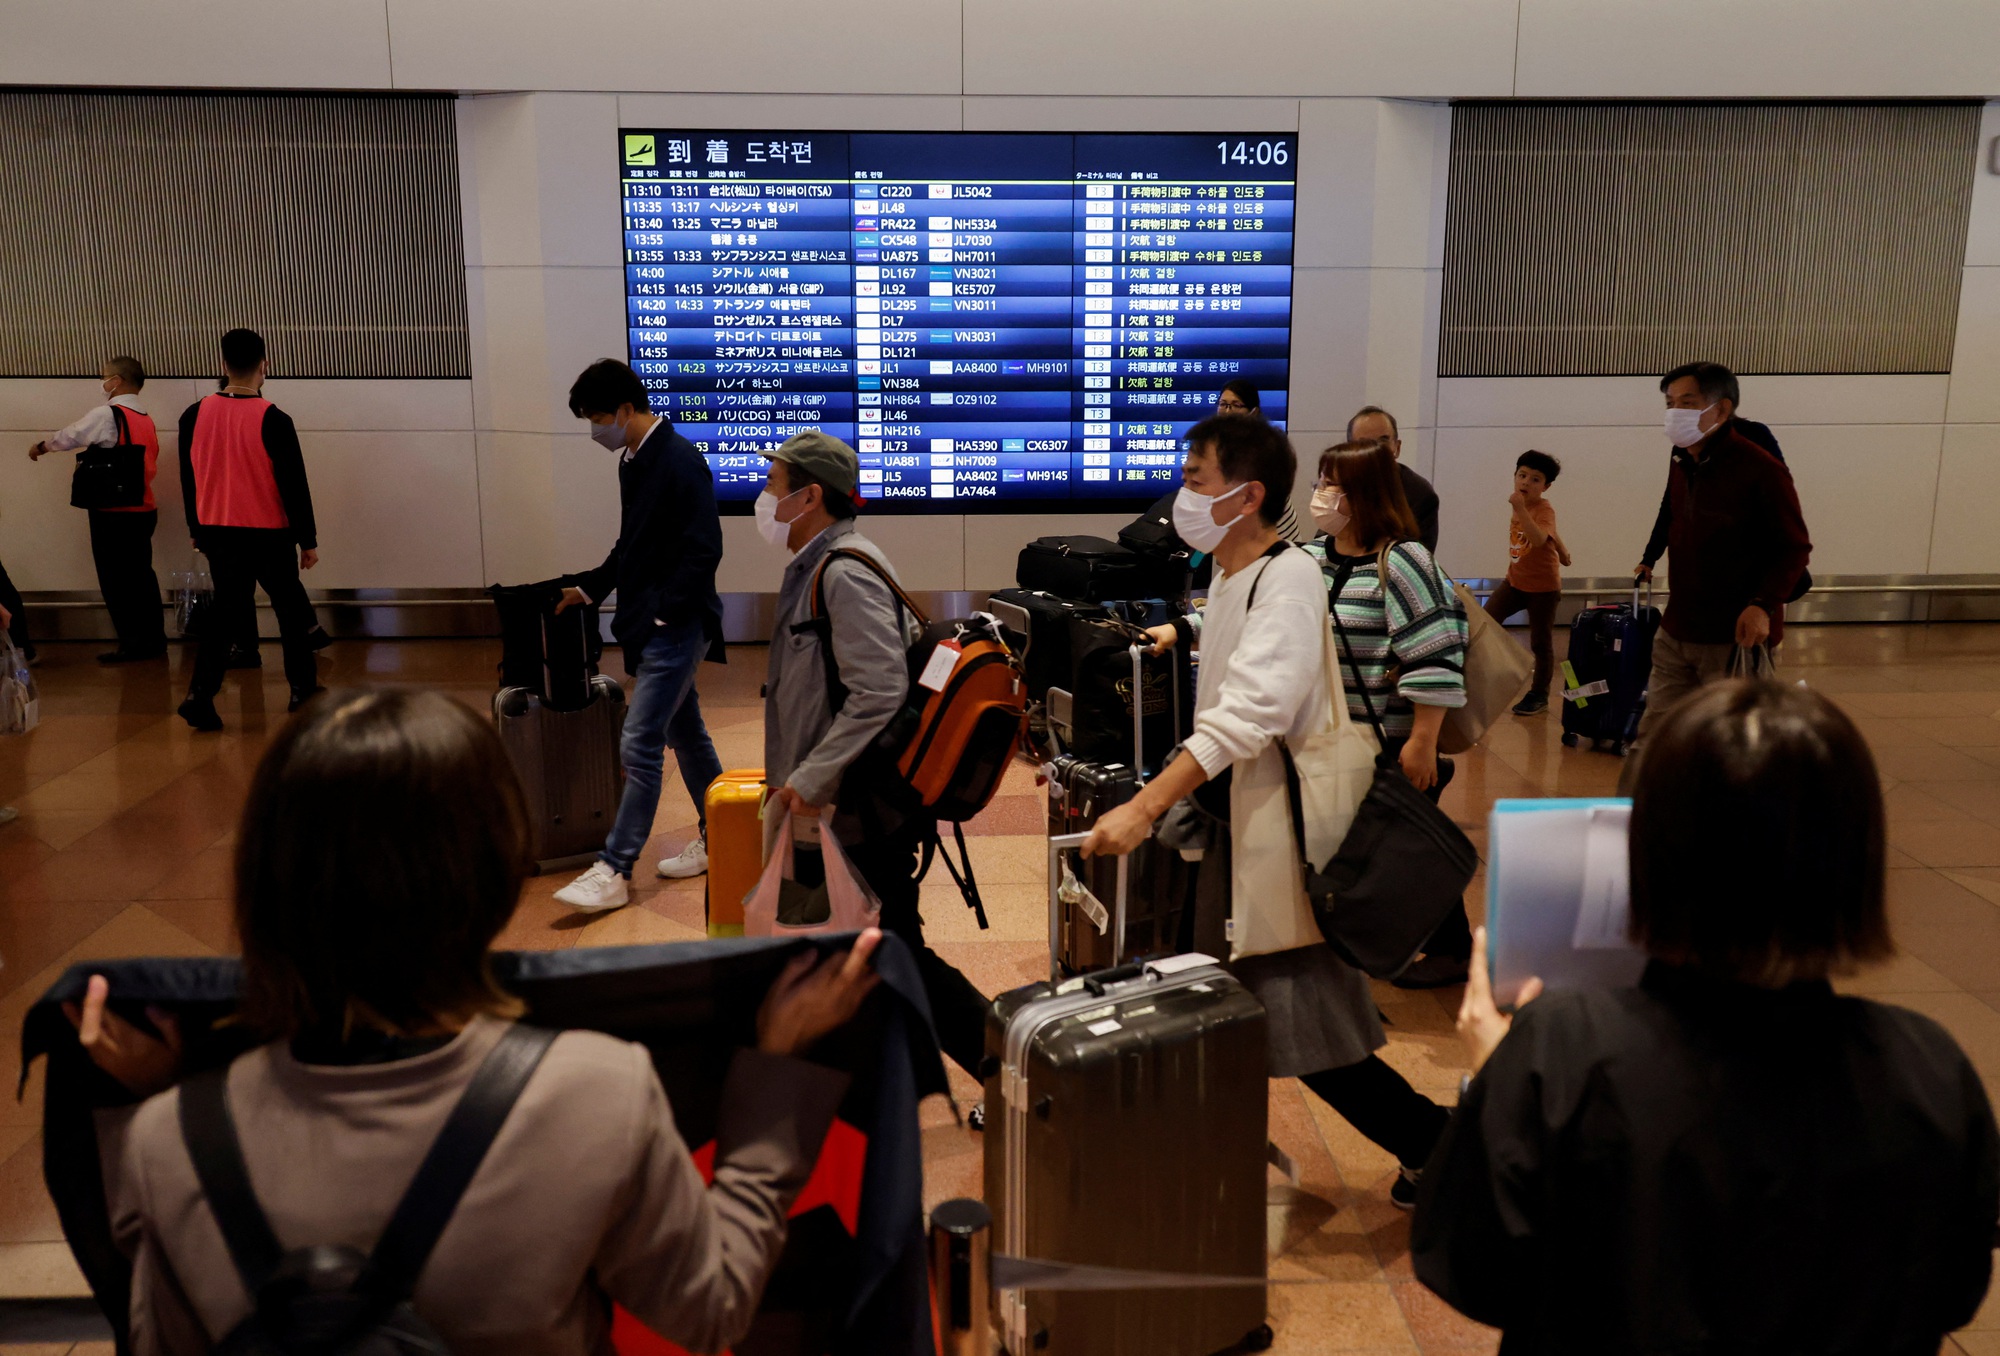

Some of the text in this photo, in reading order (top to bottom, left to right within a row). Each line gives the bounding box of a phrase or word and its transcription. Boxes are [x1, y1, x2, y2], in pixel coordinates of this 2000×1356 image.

[669, 140, 811, 163] 到 着 도착편
[1218, 142, 1287, 164] 14:06
[633, 185, 661, 196] 13:10
[671, 186, 698, 196] 13:11
[709, 185, 832, 197] 台北(松山) 타이베이(TSA)
[881, 187, 912, 197] CI220
[954, 187, 991, 197] JL5042
[1131, 187, 1264, 198] 手荷物引渡中 수하물 인도중
[633, 202, 661, 212] 13:35
[672, 202, 700, 212] 13:17
[710, 202, 798, 213] ヘルシンキ 헬싱키
[880, 203, 905, 213] JL48
[1131, 203, 1264, 214] 手荷物引渡中 수하물 인도중
[634, 218, 662, 228] 13:40
[672, 218, 700, 229] 13:25
[711, 218, 778, 229] マニラ 마닐라
[881, 219, 915, 229] PR422
[955, 219, 997, 230] NH5334
[1130, 219, 1263, 230] 手荷物引渡中 수하물 인도중
[635, 234, 663, 245] 13:55
[711, 234, 757, 245] 香港 홍콩
[881, 235, 916, 245] CX548
[954, 235, 992, 246] JL7030
[1130, 235, 1176, 246] 欠航 결항
[635, 251, 663, 261] 13:55
[674, 251, 701, 261] 13:33
[711, 251, 786, 261] サンフランシスコ
[791, 251, 846, 261] 샌프란시스코
[882, 251, 918, 261] UA875
[955, 251, 995, 261] NH7011
[1130, 251, 1262, 261] 手荷物引渡中 수하물 인도중
[636, 268, 664, 278] 14:00
[713, 267, 789, 278] シアトル 시애틀
[882, 268, 916, 278] DL167
[954, 268, 995, 278] VN3021
[1130, 268, 1175, 278] 欠航 결항
[637, 284, 665, 294] 14:15
[675, 284, 703, 294] 14:15
[713, 283, 823, 294] ソウル(金浦) 서울(GMP)
[881, 284, 905, 294] JL92
[955, 284, 995, 294] KE5707
[1129, 284, 1241, 294] 共同運航便 공동 운항편
[637, 300, 666, 310] 14:20
[675, 300, 703, 310] 14:33
[713, 300, 764, 310] アトランタ
[882, 300, 916, 310] DL295
[954, 300, 995, 310] VN3011
[1129, 299, 1241, 310] 共同運航便 공동 운항편
[638, 316, 666, 326] 14:40
[714, 315, 775, 325] ロサンゼルス
[883, 316, 903, 326] DL7
[1129, 315, 1174, 326] 欠航 결항
[639, 332, 667, 342] 14:40
[714, 331, 822, 341] デトロイト 디트로이트
[883, 332, 916, 342] DL275
[955, 332, 995, 342] VN3031
[1129, 331, 1174, 341] 欠航 결항
[640, 348, 667, 357] 14:55
[716, 347, 842, 357] ミネアポリス 미니애폴리스
[883, 348, 915, 357] DL121
[1129, 346, 1174, 357] 欠航 결항
[640, 363, 668, 373] 15:00
[678, 364, 705, 373] 14:23
[715, 363, 848, 373] サンフランシスコ 샌프란시스코
[882, 363, 898, 373] JL1
[955, 363, 997, 373] AA8400
[1027, 363, 1067, 372] MH9101
[1128, 362, 1238, 372] 共同運航便 공동 운항편
[641, 379, 668, 389] 15:05
[716, 378, 781, 388] ハノイ 하노이
[883, 379, 919, 388] VN384
[1128, 377, 1173, 387] 欠航 결항
[648, 396, 669, 405] 5:20
[680, 396, 705, 405] 15:01
[717, 395, 826, 405] ソウル(金浦) 서울(GMP)
[884, 395, 920, 404] NH864
[956, 395, 996, 404] OZ9102
[1128, 394, 1176, 404] 共同運航便
[1182, 394, 1202, 404] 공동
[680, 411, 707, 421] 15:34
[718, 410, 820, 421] パリ(CDG) 파리(CDG)
[884, 411, 907, 420] JL46
[718, 426, 771, 436] パリ(CDG)
[885, 426, 921, 435] NH216
[1128, 425, 1172, 434] 欠航 결항
[718, 442, 760, 454] ホノルル
[884, 441, 907, 451] JL73
[956, 441, 997, 450] HA5390
[1027, 441, 1067, 450] CX6307
[1127, 440, 1175, 450] 共同運航便
[719, 456, 769, 466] シカゴ・オ
[885, 456, 919, 466] UA881
[956, 456, 997, 466] NH7009
[1127, 455, 1175, 465] 共同運航便
[719, 472, 767, 481] ニューヨー
[884, 472, 901, 481] JL5
[956, 471, 997, 481] AA8402
[1027, 471, 1067, 480] MH9145
[1152, 470, 1171, 479] 지연
[885, 487, 926, 496] BA4605
[956, 486, 996, 496] LA7464
